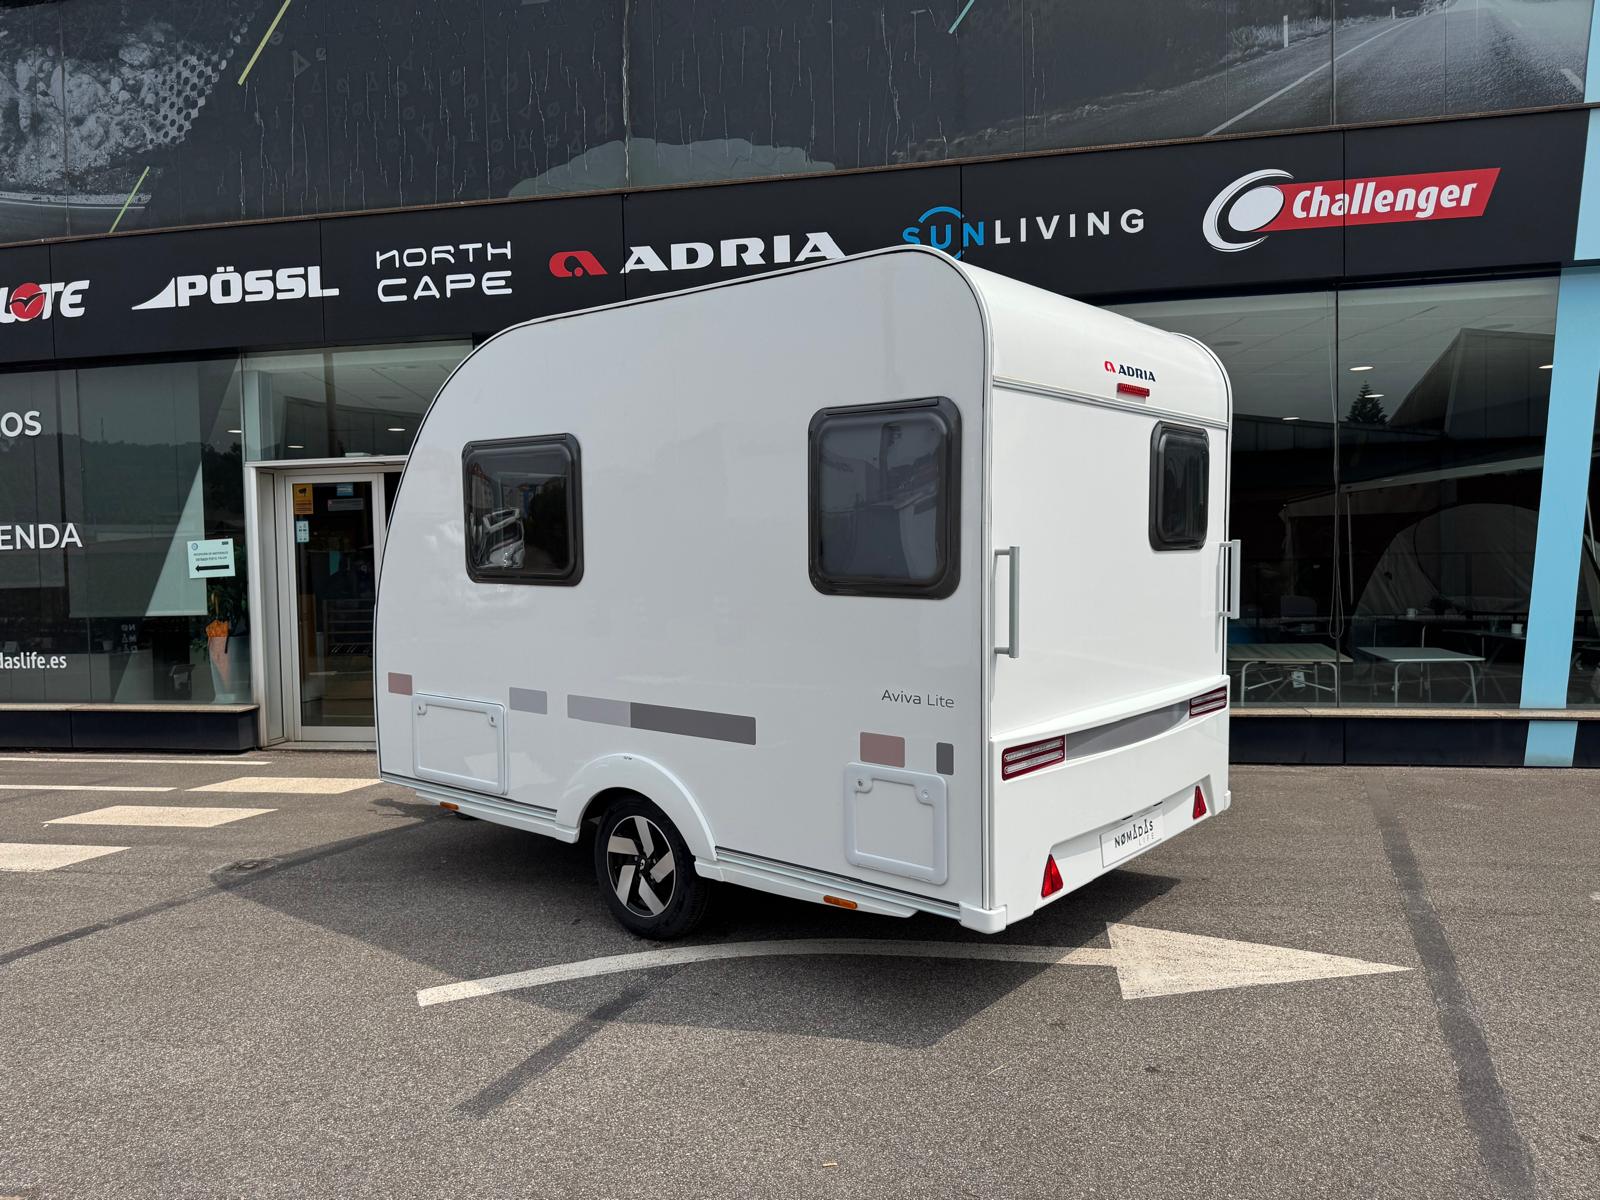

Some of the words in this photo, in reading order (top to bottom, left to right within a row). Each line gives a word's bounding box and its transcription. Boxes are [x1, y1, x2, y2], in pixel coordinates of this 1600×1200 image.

[1292, 181, 1477, 219] Challenger
[376, 241, 511, 269] NORTH
[620, 231, 846, 274] ADRIA
[177, 266, 339, 307] PÖSSL
[377, 270, 512, 302] CAPE
[1118, 364, 1156, 382] ADRIA
[881, 689, 921, 704] Aviva
[927, 694, 954, 708] Lite
